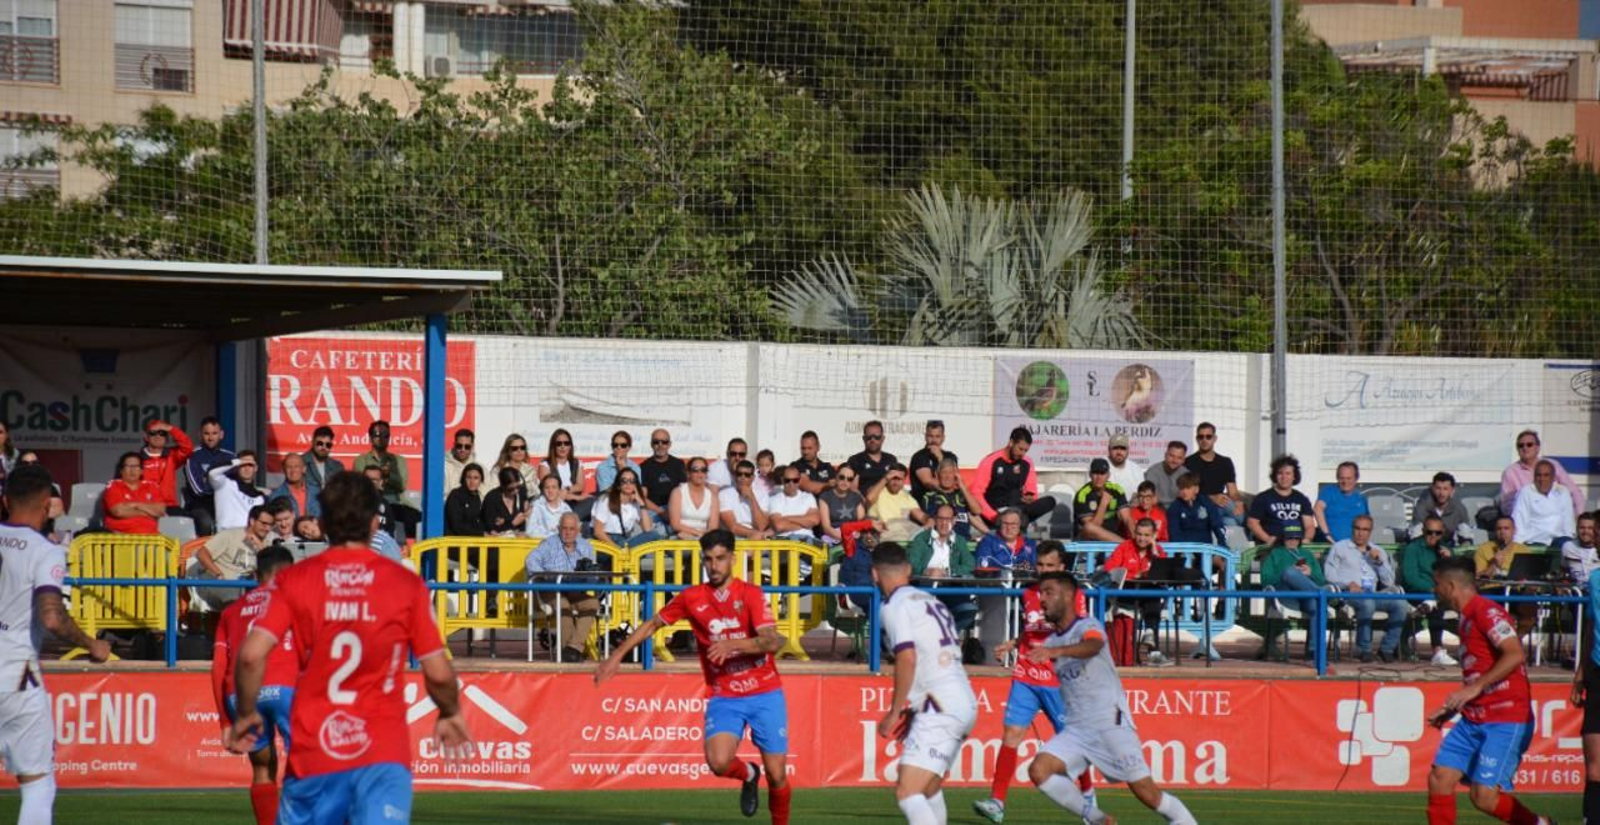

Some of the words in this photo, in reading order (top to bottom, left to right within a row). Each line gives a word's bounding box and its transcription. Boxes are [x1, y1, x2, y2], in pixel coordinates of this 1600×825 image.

[289, 348, 422, 371] CAFETERÍ
[325, 602, 358, 621] IVAN
[362, 602, 377, 621] L.
[327, 631, 363, 705] 2
[624, 698, 662, 713] SAN
[48, 692, 157, 745] GENIO
[604, 726, 703, 742] SALADERO
[91, 759, 138, 771] Centre
[1551, 769, 1581, 785] 616
